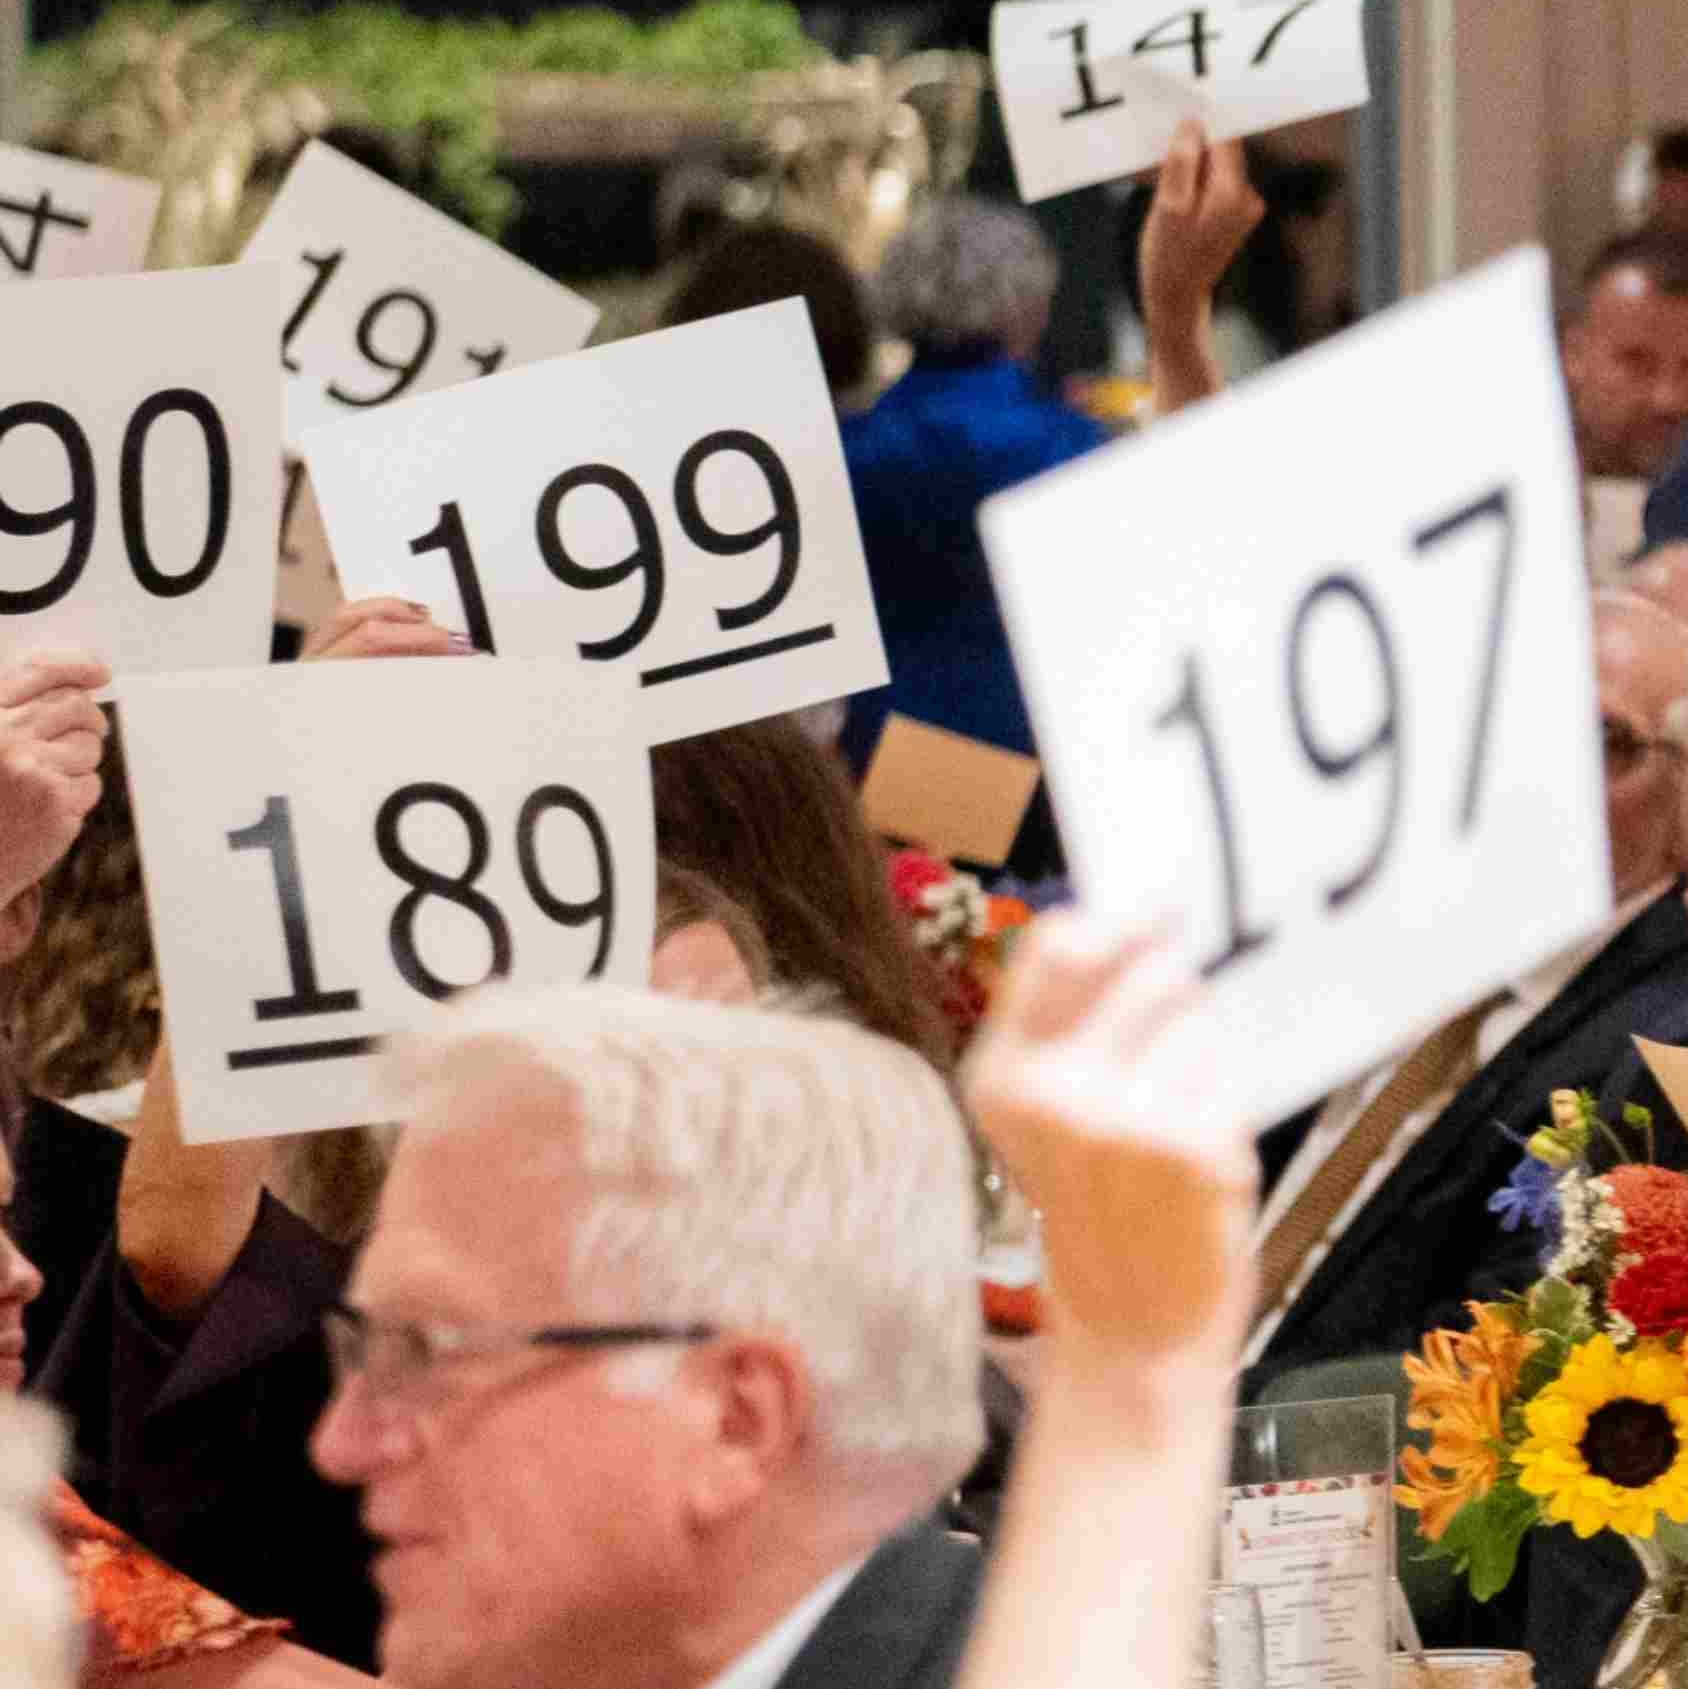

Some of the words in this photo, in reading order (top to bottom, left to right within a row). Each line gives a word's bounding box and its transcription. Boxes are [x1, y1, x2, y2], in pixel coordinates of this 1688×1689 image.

[281, 247, 507, 406] 19
[0, 387, 232, 617] 90
[408, 428, 803, 662] 199
[1153, 480, 1519, 984] 197
[226, 780, 616, 1023] 189
